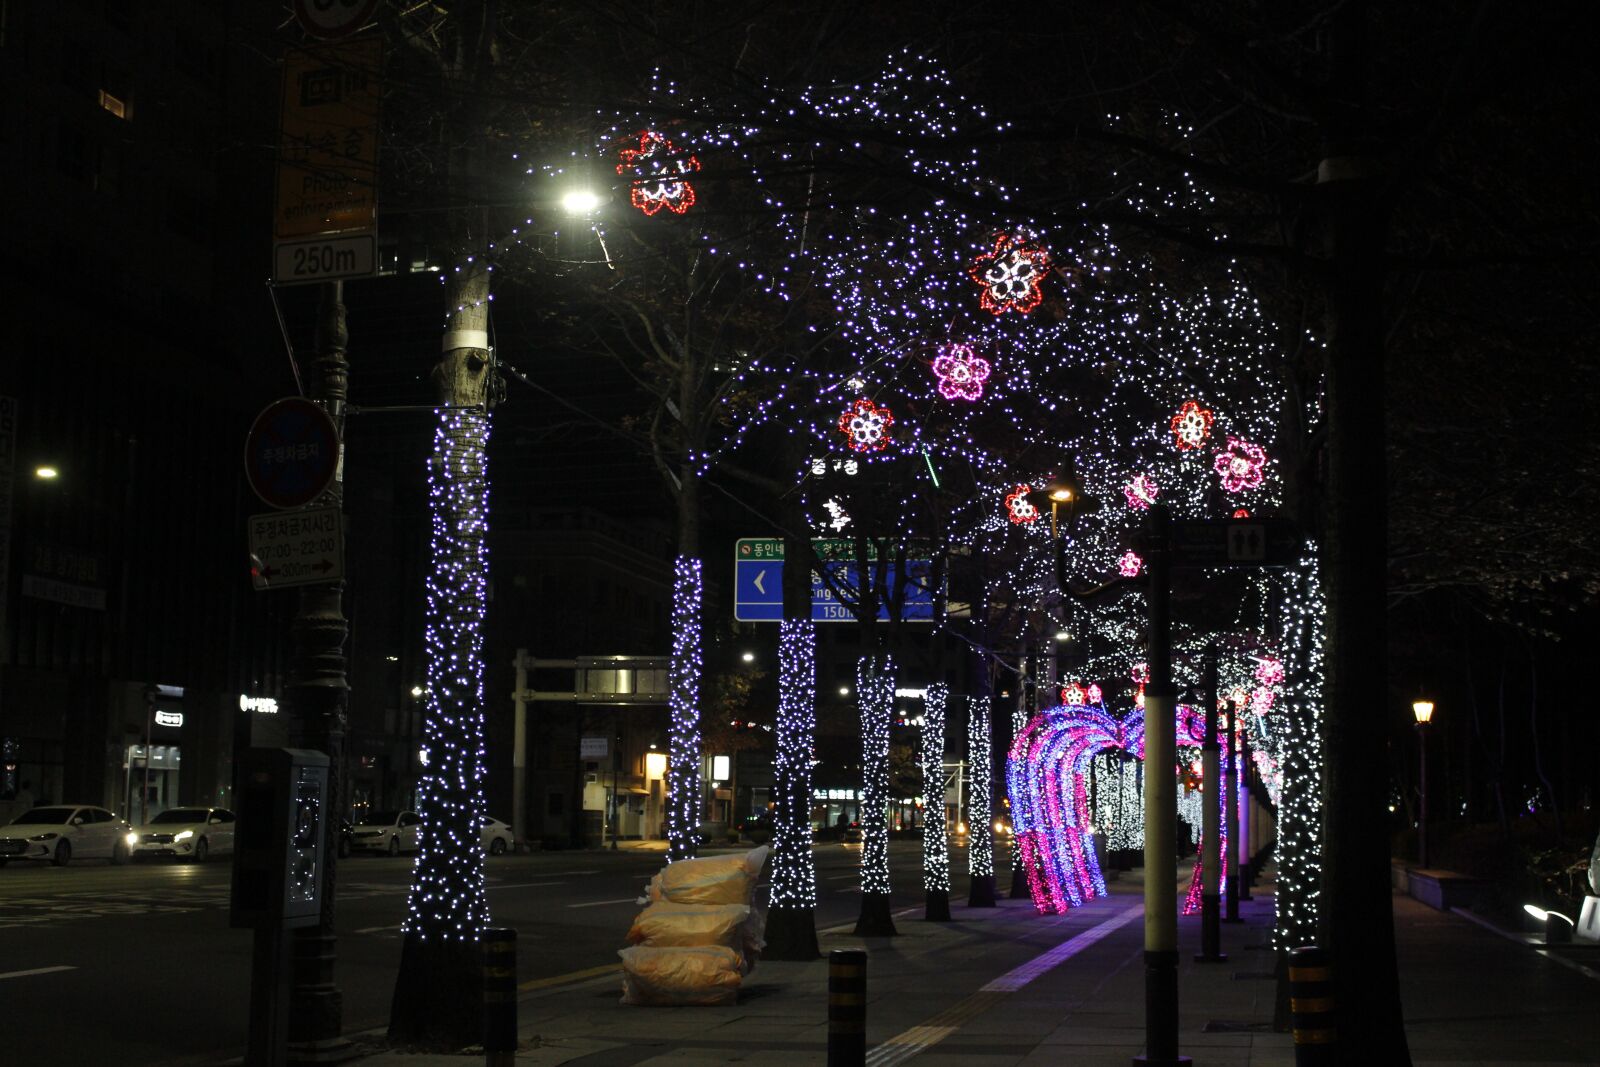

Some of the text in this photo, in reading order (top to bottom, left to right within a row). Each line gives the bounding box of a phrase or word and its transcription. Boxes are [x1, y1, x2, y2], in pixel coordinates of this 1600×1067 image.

[302, 173, 348, 194] Photo
[293, 245, 356, 275] 250m
[263, 442, 319, 464] 주정차금지
[255, 515, 335, 539] 주정차금지시간
[281, 561, 312, 577] 300m
